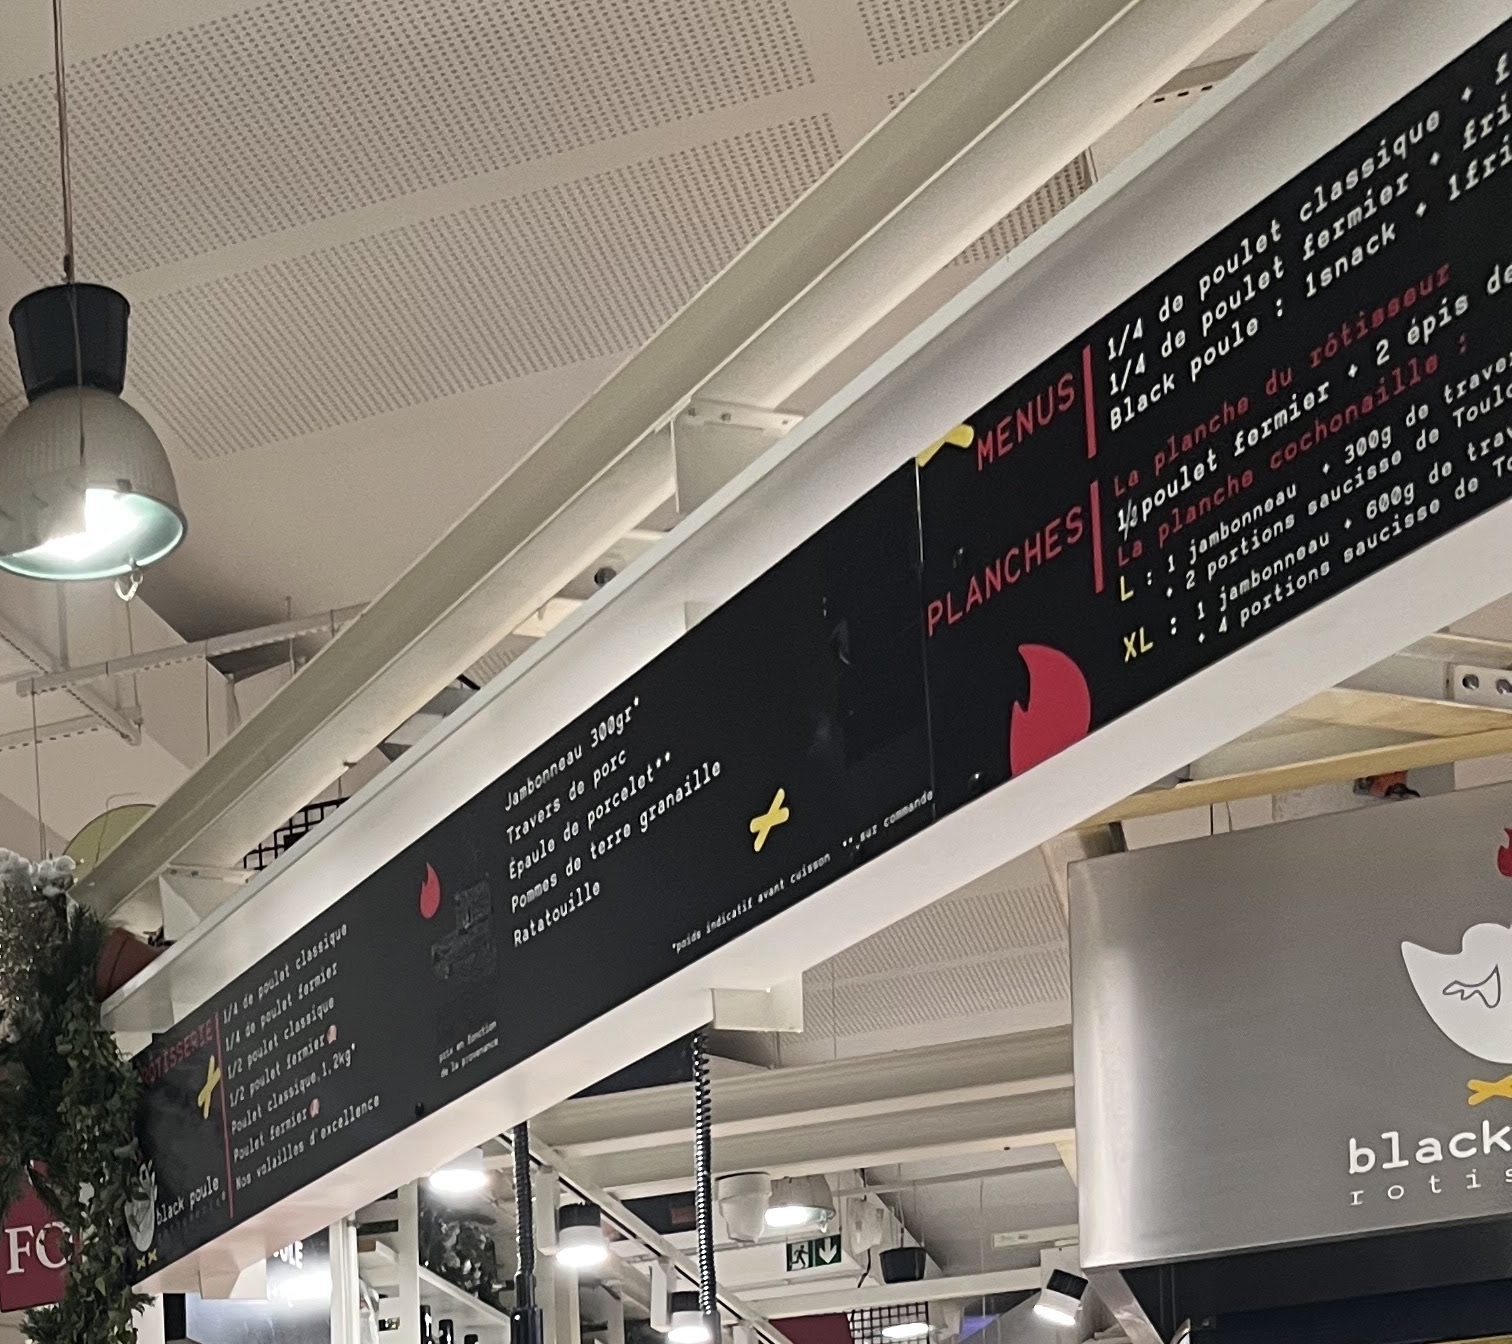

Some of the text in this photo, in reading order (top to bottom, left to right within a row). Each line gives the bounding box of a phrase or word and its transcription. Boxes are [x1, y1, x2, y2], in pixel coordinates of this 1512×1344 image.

[1108, 111, 1439, 360] 1/4 de poulet classique
[1110, 353, 1145, 395] 1/4
[1161, 330, 1185, 357] de
[1202, 256, 1284, 337] poulet
[1303, 173, 1408, 261] fermier
[977, 372, 1074, 471] MENUS
[1110, 373, 1175, 431] Black
[1190, 318, 1258, 382] poule
[1114, 263, 1449, 496] La planche du rôtisseur
[1142, 448, 1216, 521] poulet
[1234, 381, 1330, 456] fermier
[1377, 339, 1390, 365] 2
[1407, 294, 1469, 344] épis
[1118, 539, 1143, 567] La
[1159, 469, 1253, 548] planche
[1120, 576, 1134, 601] L
[1190, 483, 1296, 564] jambonneau
[1345, 426, 1391, 464] 300g
[1406, 404, 1428, 427] de
[1186, 570, 1196, 591] 2
[1208, 514, 1294, 581] portions
[1308, 450, 1401, 515] saucisse
[1416, 428, 1439, 450] de
[927, 506, 1083, 637] PLANCHES
[1123, 627, 1153, 662] XL
[1219, 531, 1330, 612] jambonneau
[1366, 482, 1414, 519] 600g
[1429, 462, 1452, 484] de
[1218, 616, 1227, 633] 4
[1240, 560, 1330, 627] portions
[1344, 499, 1440, 563] saucisse
[1454, 477, 1478, 499] de
[505, 745, 583, 811] Jambonneau
[506, 749, 626, 844] Travers de porc
[509, 838, 555, 880] Épaule
[563, 821, 579, 842] de
[511, 761, 721, 913] Pommes de terre granaille
[706, 898, 753, 934] indicatif
[757, 879, 785, 904] avant
[790, 853, 830, 884] cuisson
[883, 789, 934, 828] commande
[514, 881, 600, 947] Ratatouille
[242, 991, 254, 1010] de
[258, 964, 290, 999] poulet
[295, 923, 348, 970] classique
[245, 1018, 256, 1037] de
[260, 993, 292, 1027] poulet
[298, 961, 339, 1000] fermier
[227, 996, 335, 1080] 1/2 poulet classique
[230, 1033, 325, 1108] 1/2 poulet fermier
[231, 1106, 263, 1135] Poulet
[233, 1106, 308, 1163] Poulet fermier
[236, 1094, 380, 1191] Nos volailles d'excellence
[1349, 1119, 1511, 1174] black
[156, 1197, 184, 1226] black
[190, 1175, 219, 1206] poule
